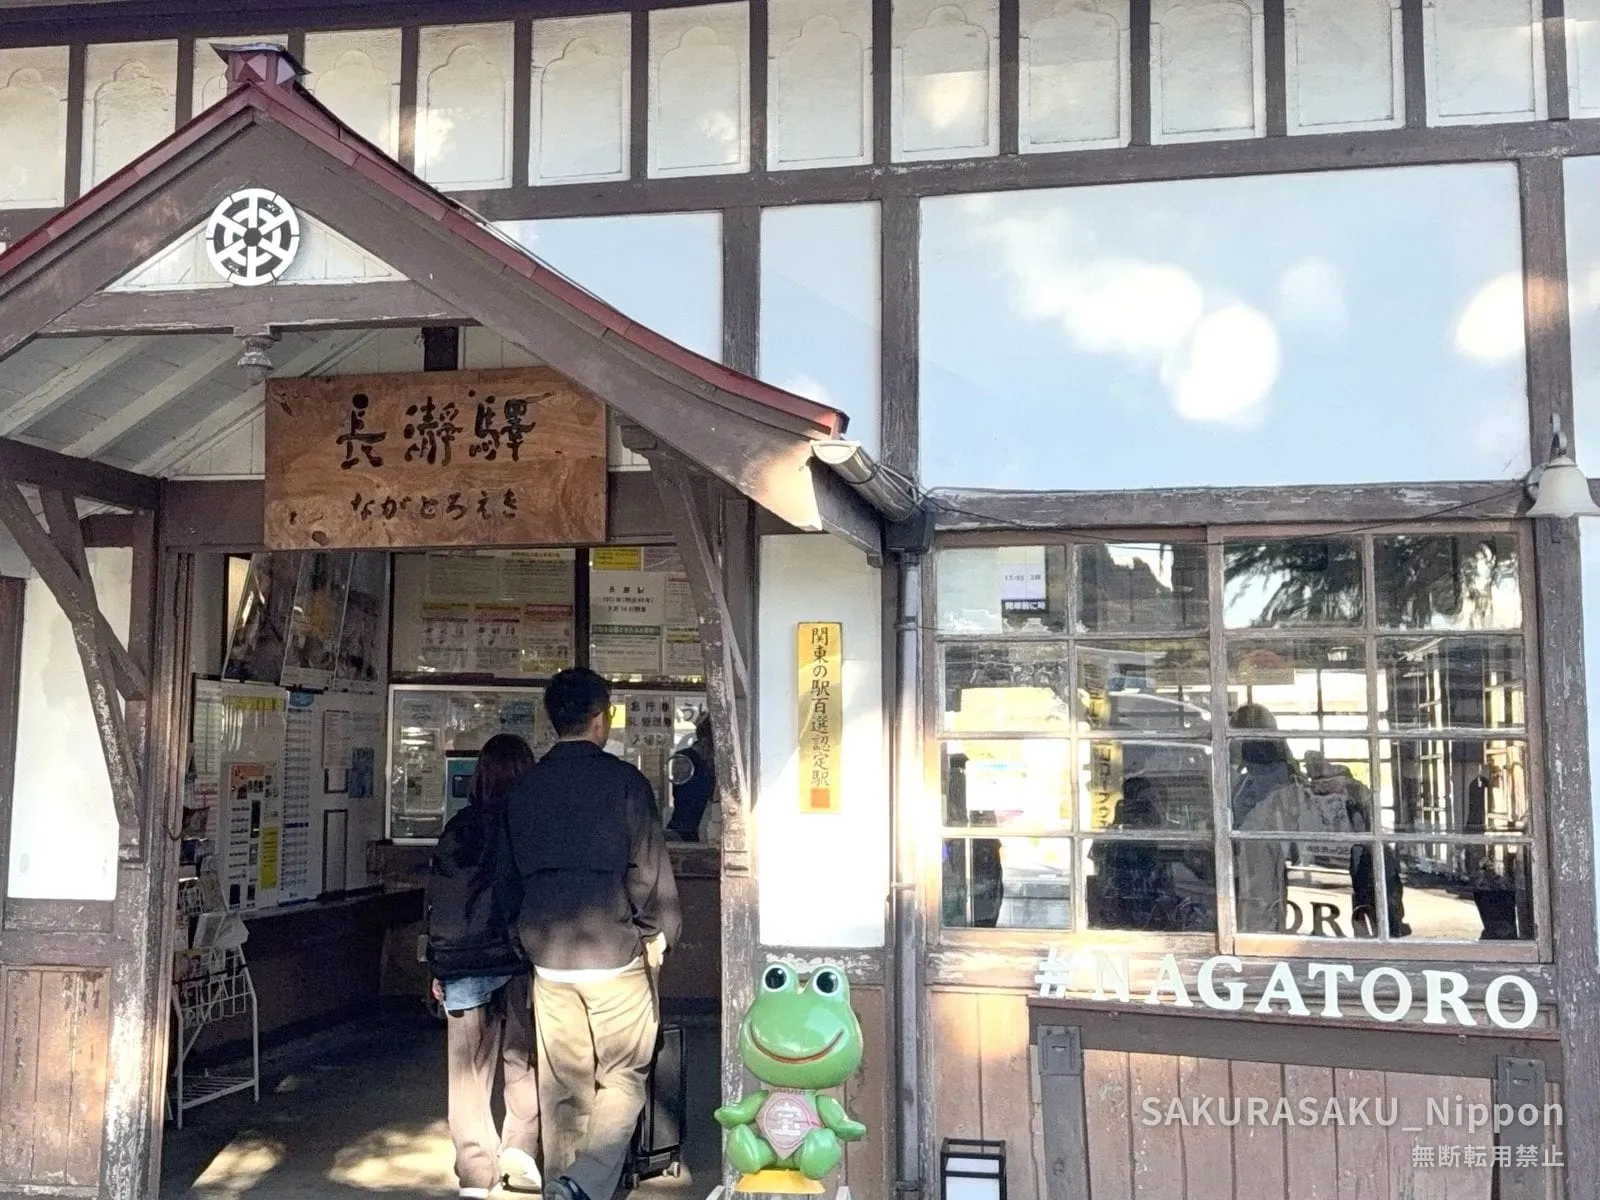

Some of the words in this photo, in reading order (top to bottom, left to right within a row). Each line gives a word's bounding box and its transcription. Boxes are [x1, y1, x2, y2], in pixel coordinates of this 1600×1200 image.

[350, 491, 518, 521] ながとろえき
[810, 626, 832, 788] 関東の駅百選認定駅
[1034, 947, 1540, 1030] #NAGATORO
